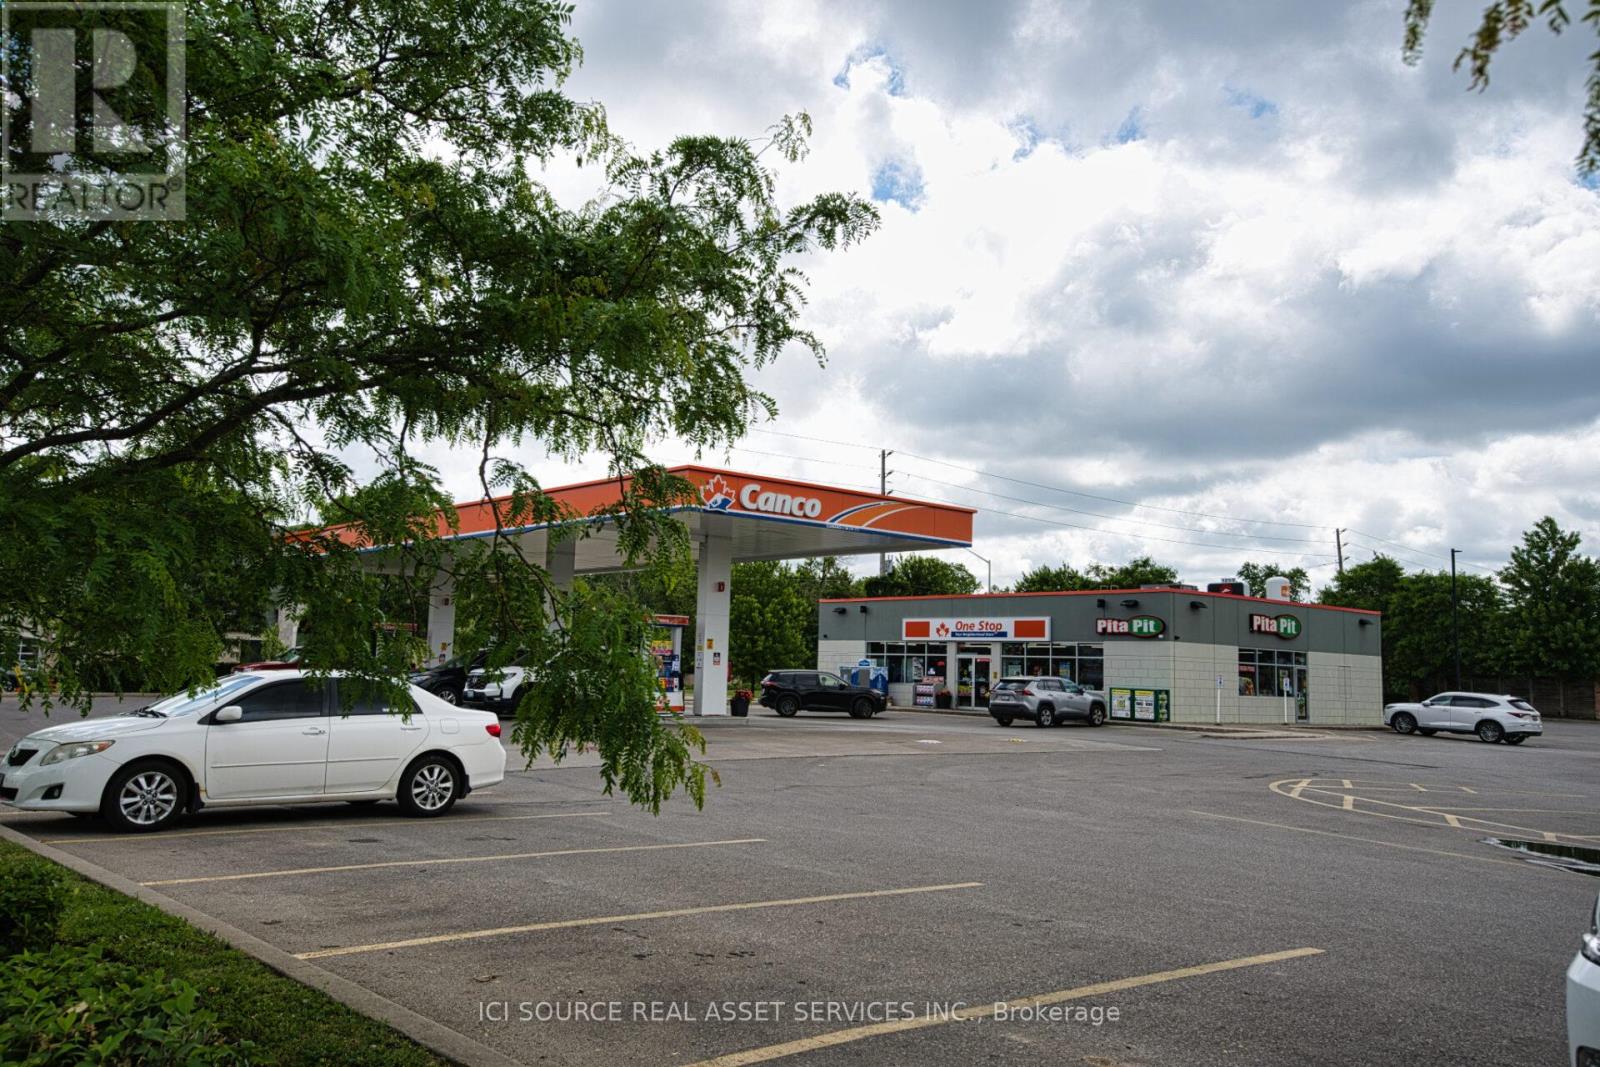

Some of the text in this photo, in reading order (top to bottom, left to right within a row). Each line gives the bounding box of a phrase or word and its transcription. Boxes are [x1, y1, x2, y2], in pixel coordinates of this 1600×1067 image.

[740, 483, 822, 518] Canco
[955, 620, 1003, 633] One Stop
[1096, 619, 1156, 633] Pita Pit
[1253, 615, 1297, 634] Pita Pit
